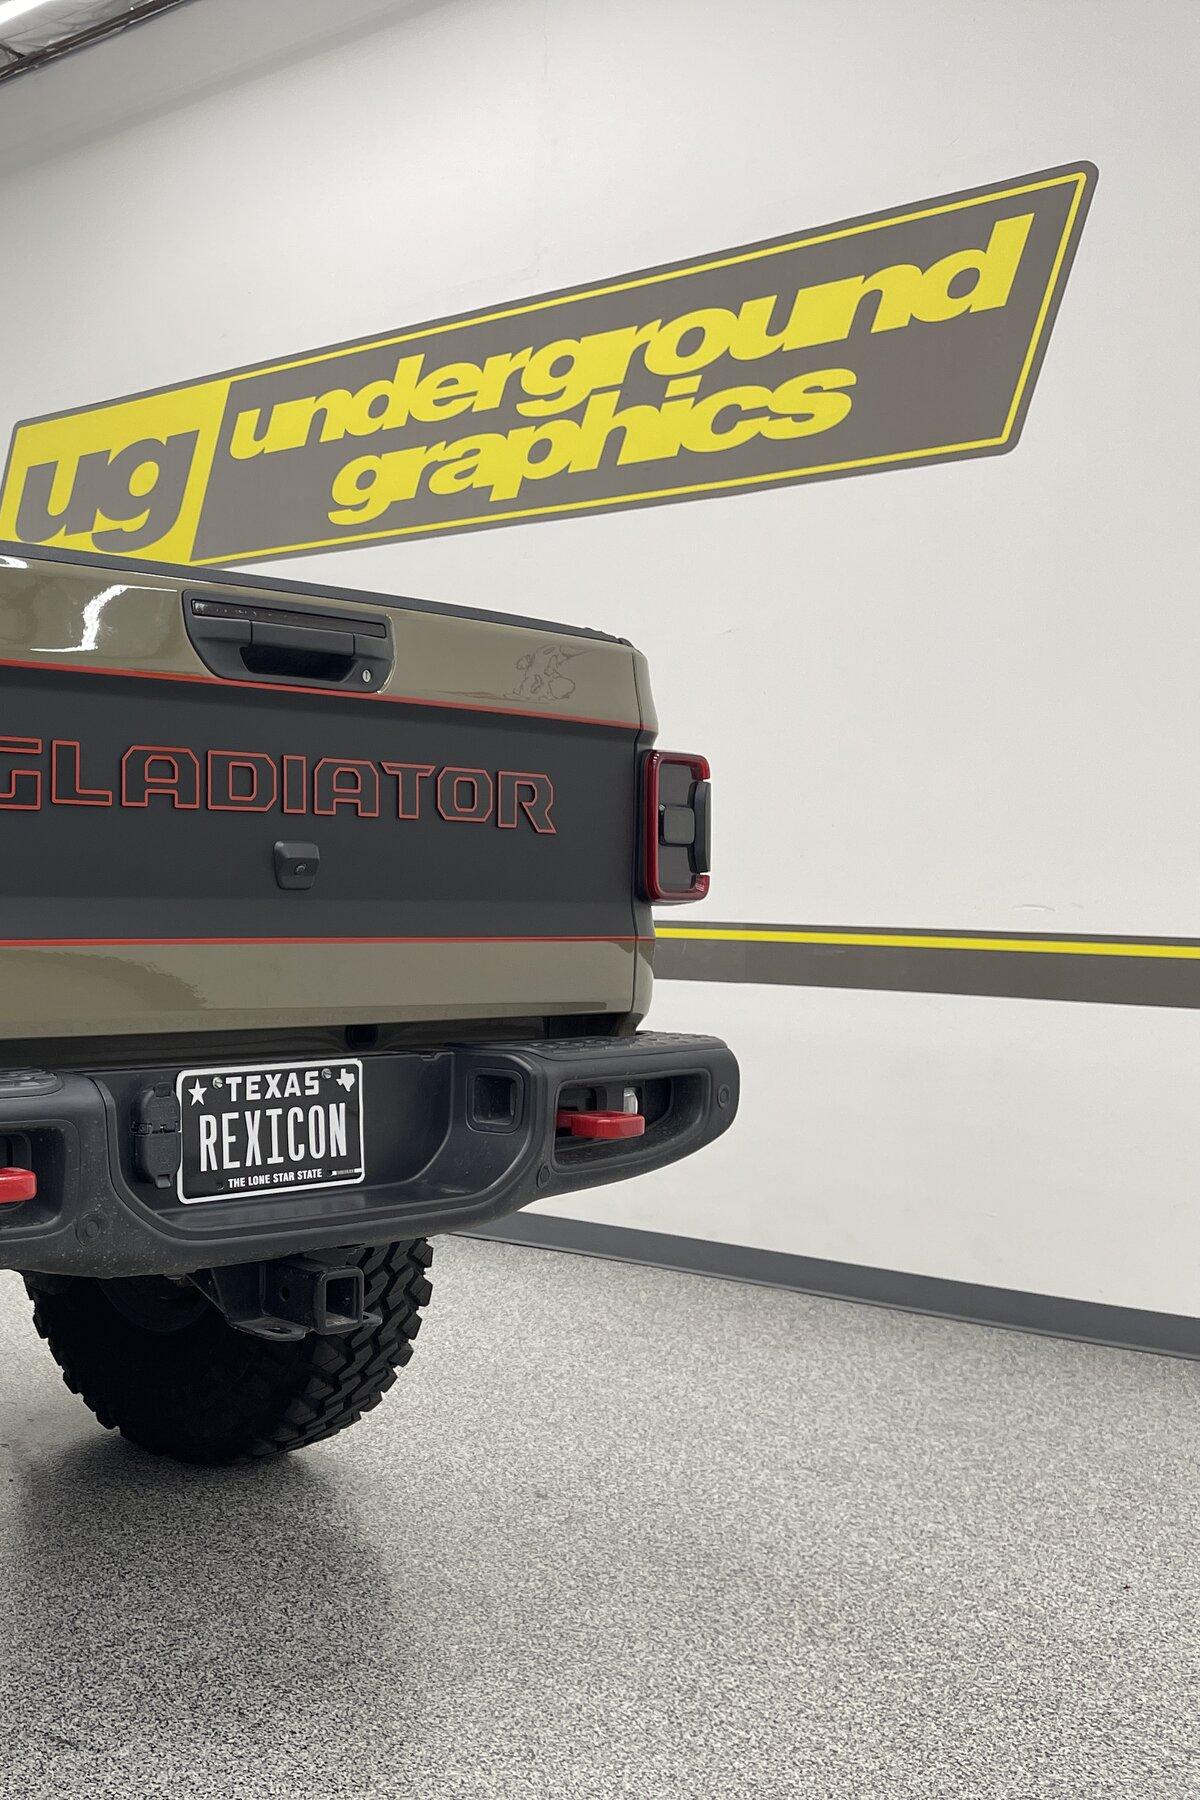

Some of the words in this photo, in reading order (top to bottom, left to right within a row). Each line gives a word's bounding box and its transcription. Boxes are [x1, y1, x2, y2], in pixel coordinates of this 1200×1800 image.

[13, 426, 201, 547] ug
[230, 212, 1036, 460] underground
[327, 367, 858, 527] graphics
[225, 1070, 320, 1102] TEXAS
[199, 1102, 348, 1172] REXICON
[228, 1177, 247, 1189] THE
[248, 1174, 271, 1185] LONE
[273, 1171, 296, 1183] STAR
[297, 1168, 323, 1180] STATE
